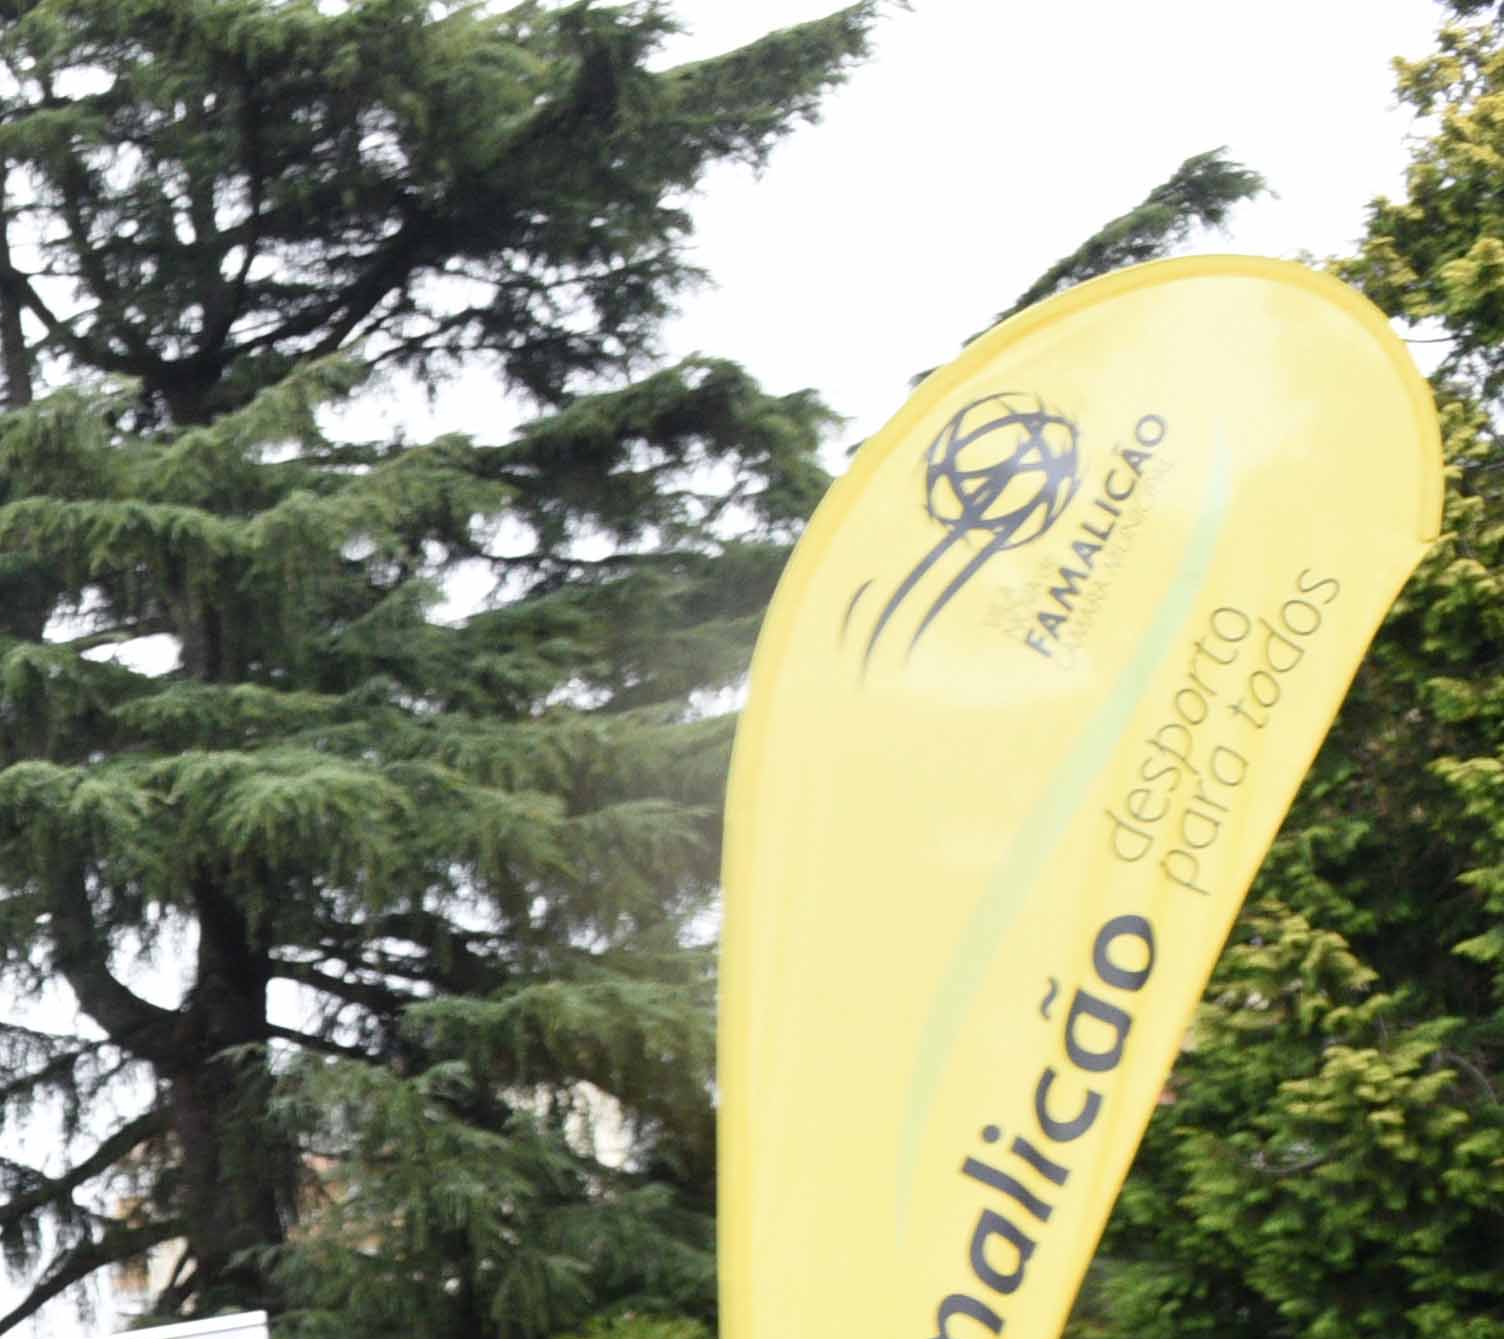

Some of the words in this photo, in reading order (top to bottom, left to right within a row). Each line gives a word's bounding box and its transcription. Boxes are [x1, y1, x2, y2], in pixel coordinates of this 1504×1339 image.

[1024, 414, 1168, 658] FAMALICÃO
[1105, 606, 1251, 862] desporto
[1159, 745, 1248, 896] para
[1229, 568, 1341, 729] todos
